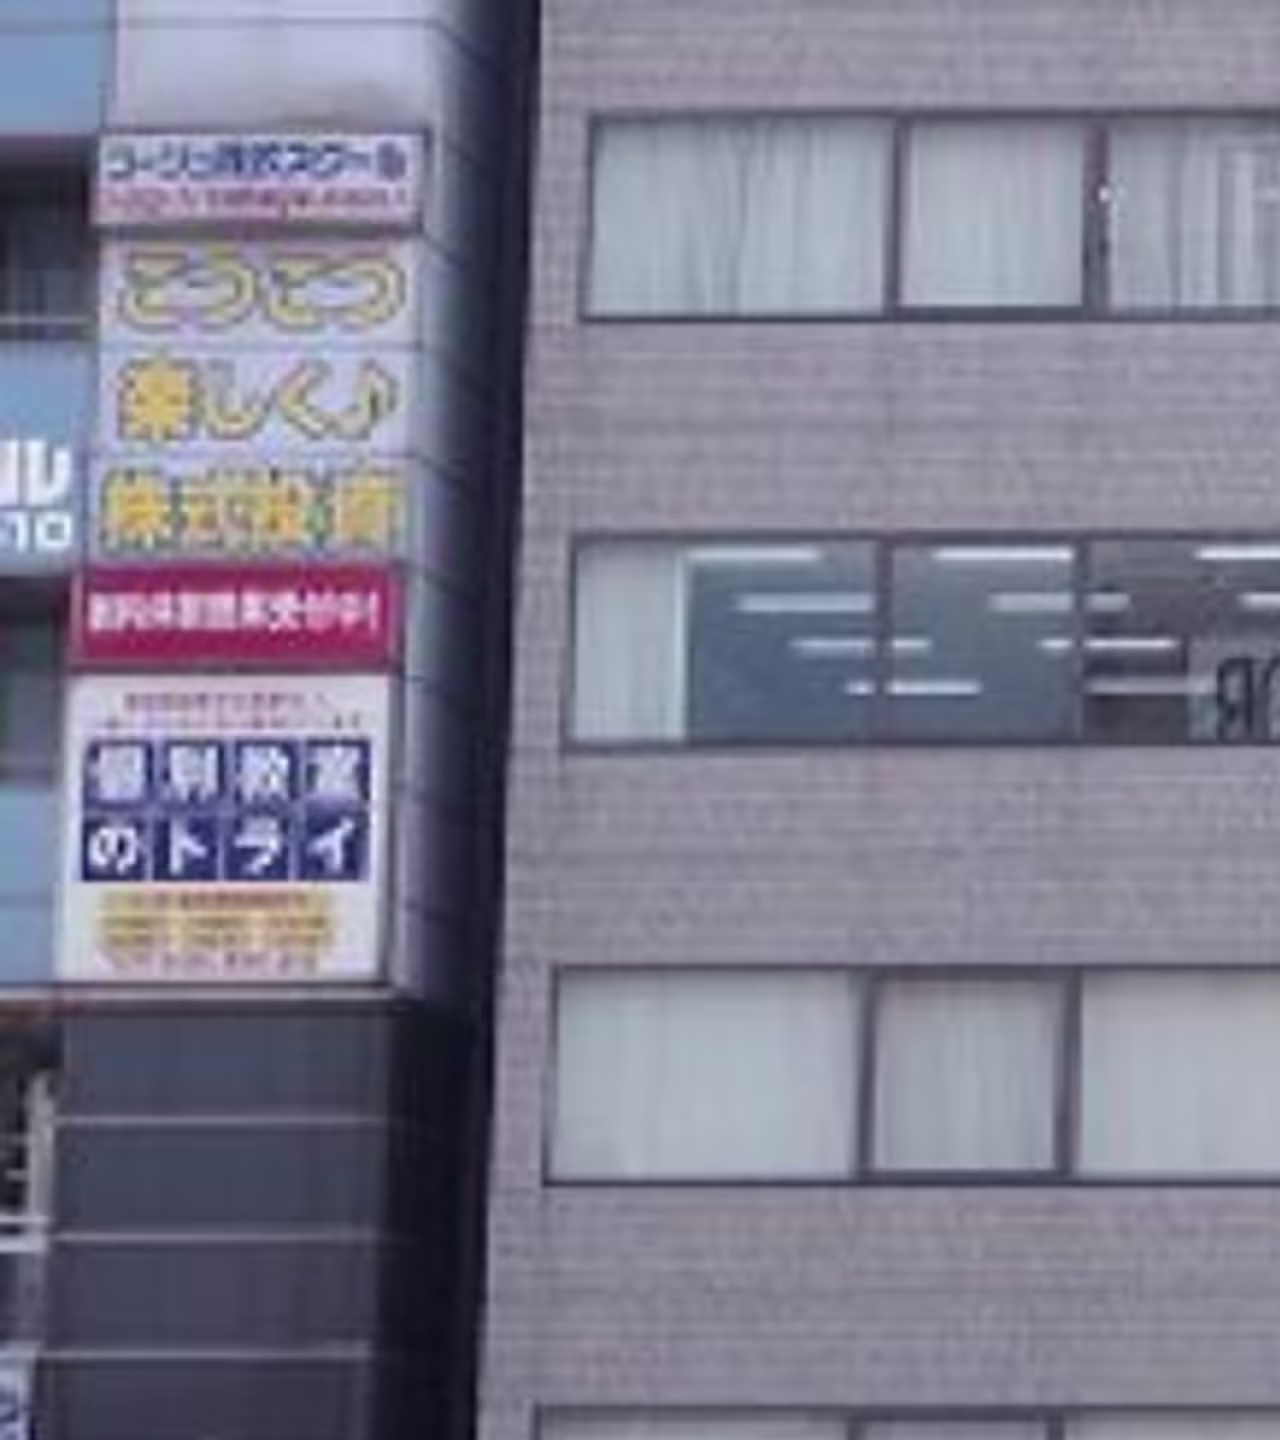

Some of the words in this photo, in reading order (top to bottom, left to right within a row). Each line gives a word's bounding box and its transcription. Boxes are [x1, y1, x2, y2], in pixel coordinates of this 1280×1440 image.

[118, 246, 406, 334] こつこつ
[86, 742, 370, 804] 個別教室
[86, 816, 370, 876] のトライ
